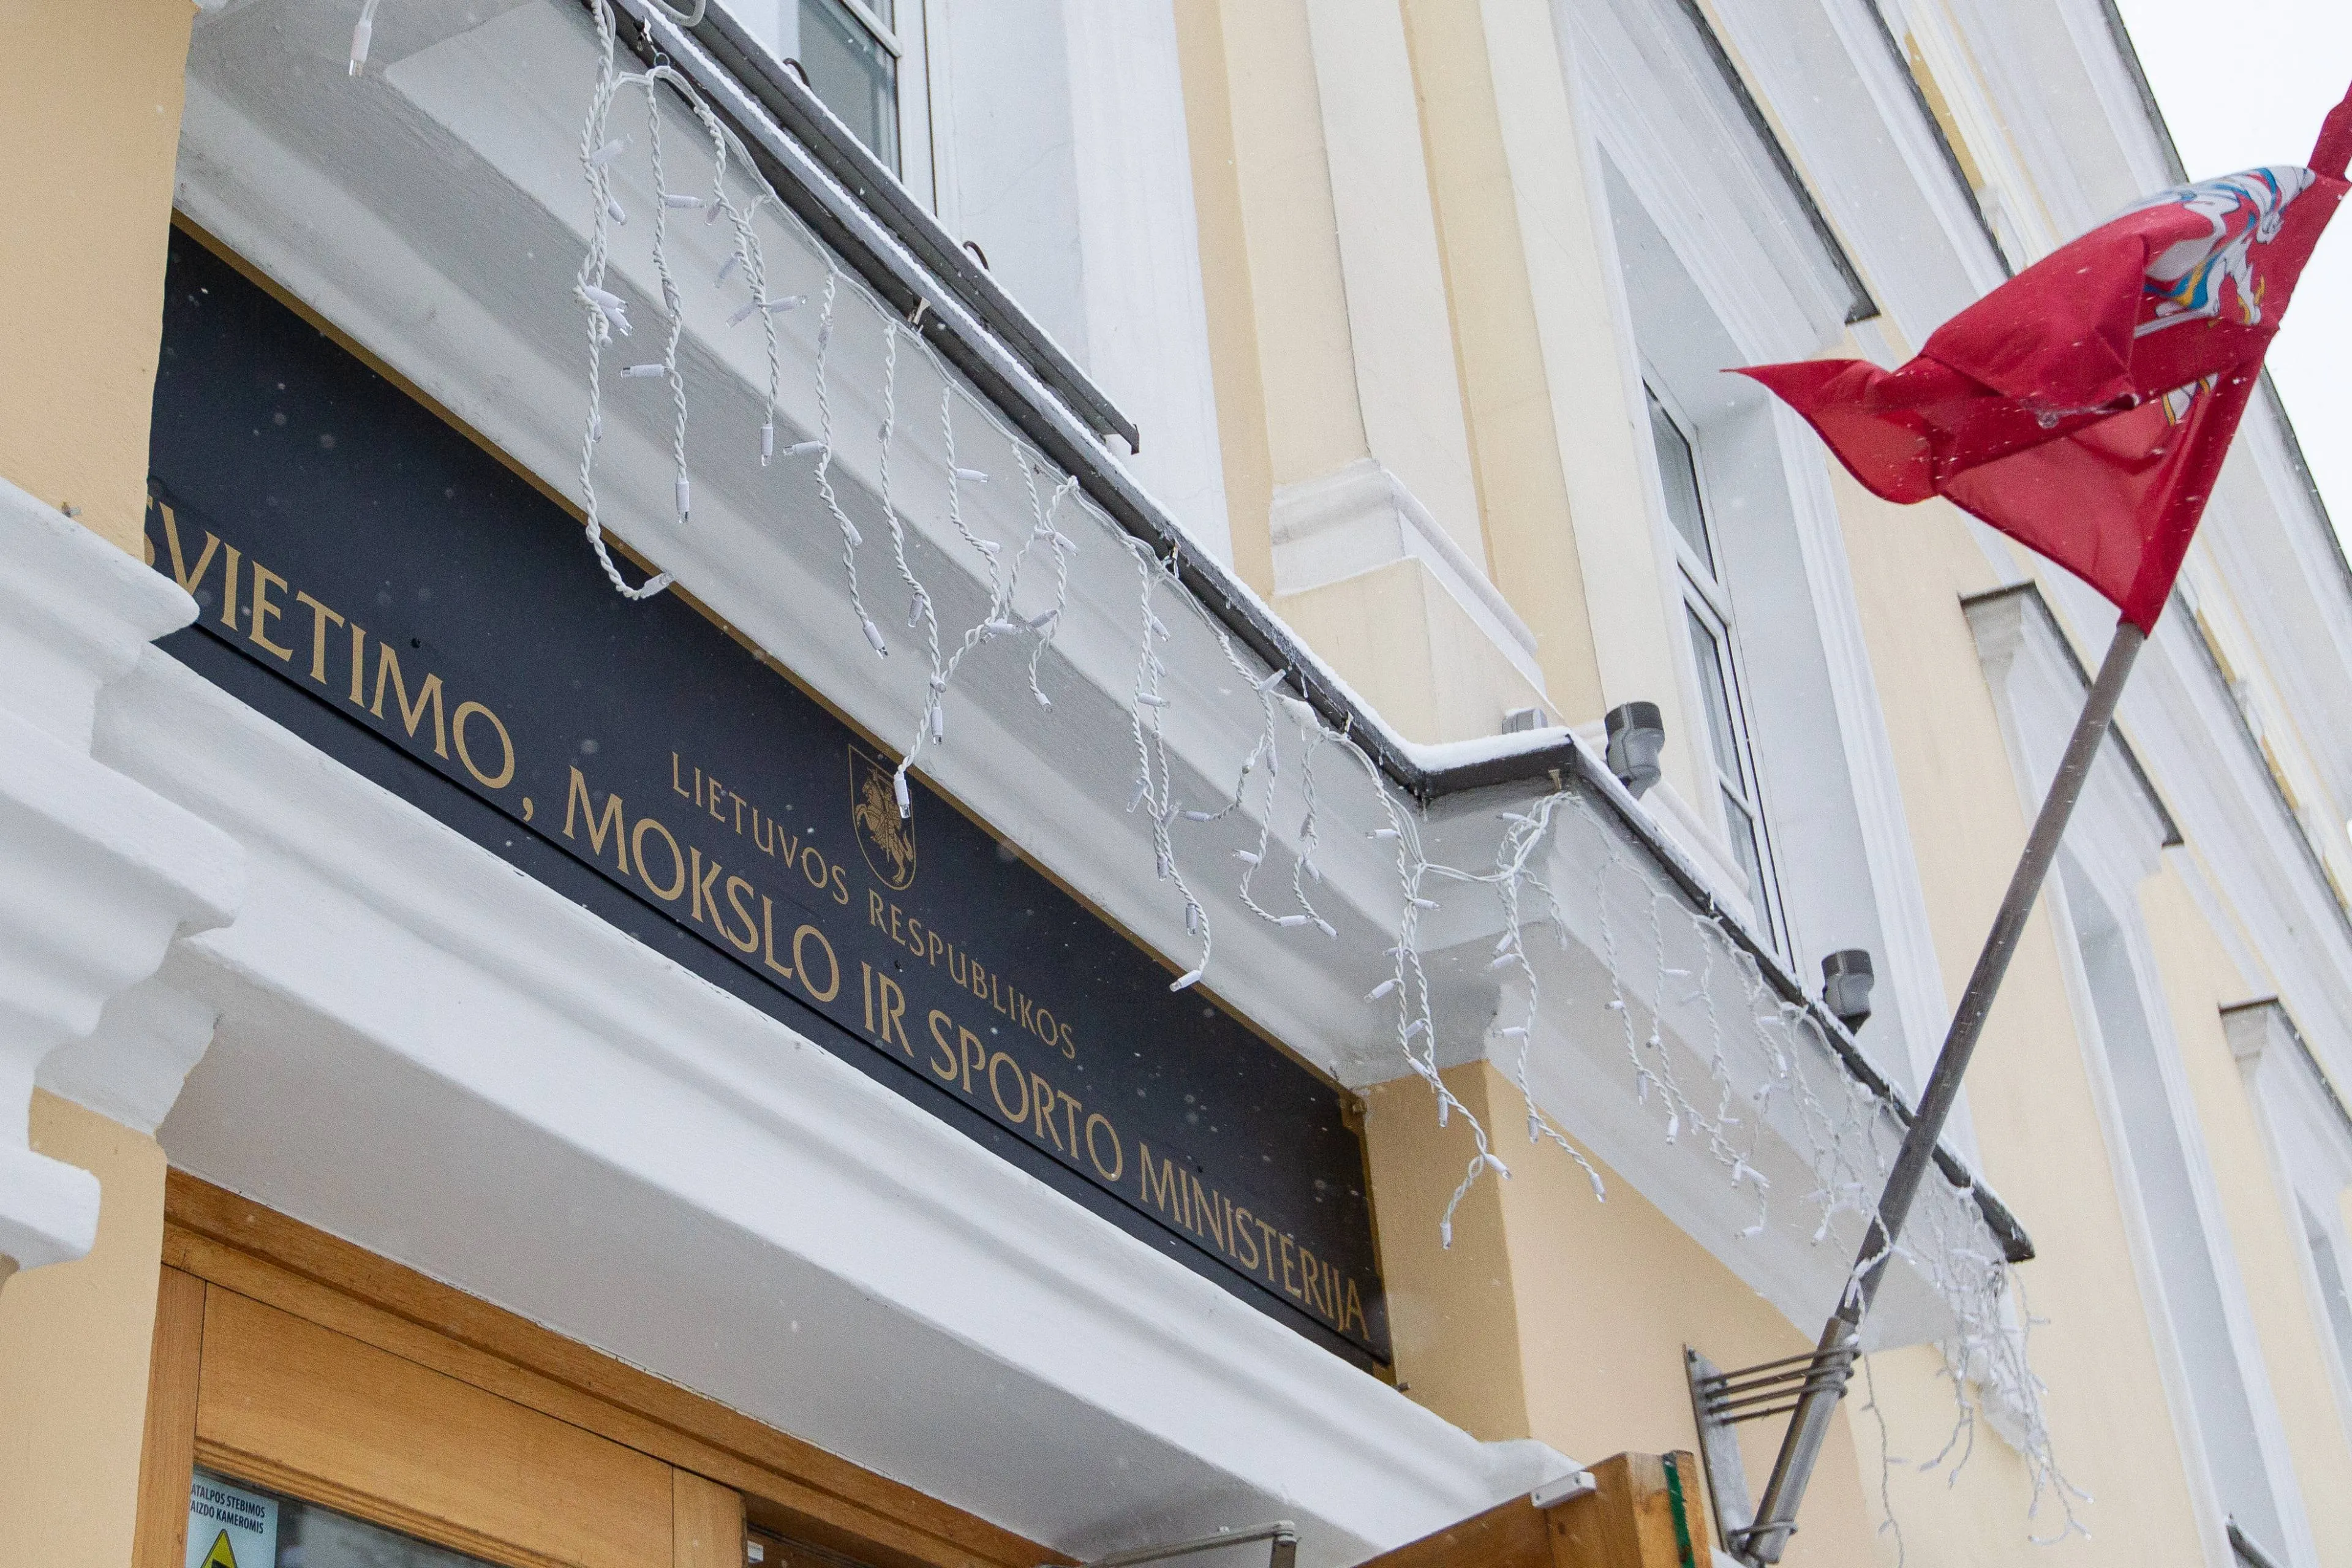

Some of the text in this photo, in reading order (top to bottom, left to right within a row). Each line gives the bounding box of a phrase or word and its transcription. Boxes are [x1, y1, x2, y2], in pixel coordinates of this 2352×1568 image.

[144, 494, 534, 822] VIETIMO,
[562, 765, 840, 1003] MOKSLO
[861, 961, 914, 1058] IR
[928, 1009, 1123, 1182] SPORTO
[673, 751, 1076, 1060] LIETUVOS RESPUBLIKOS
[190, 1500, 264, 1534] AIZDO KAMEROMIS
[191, 1483, 265, 1518] ATALPOS STEBIMOS
